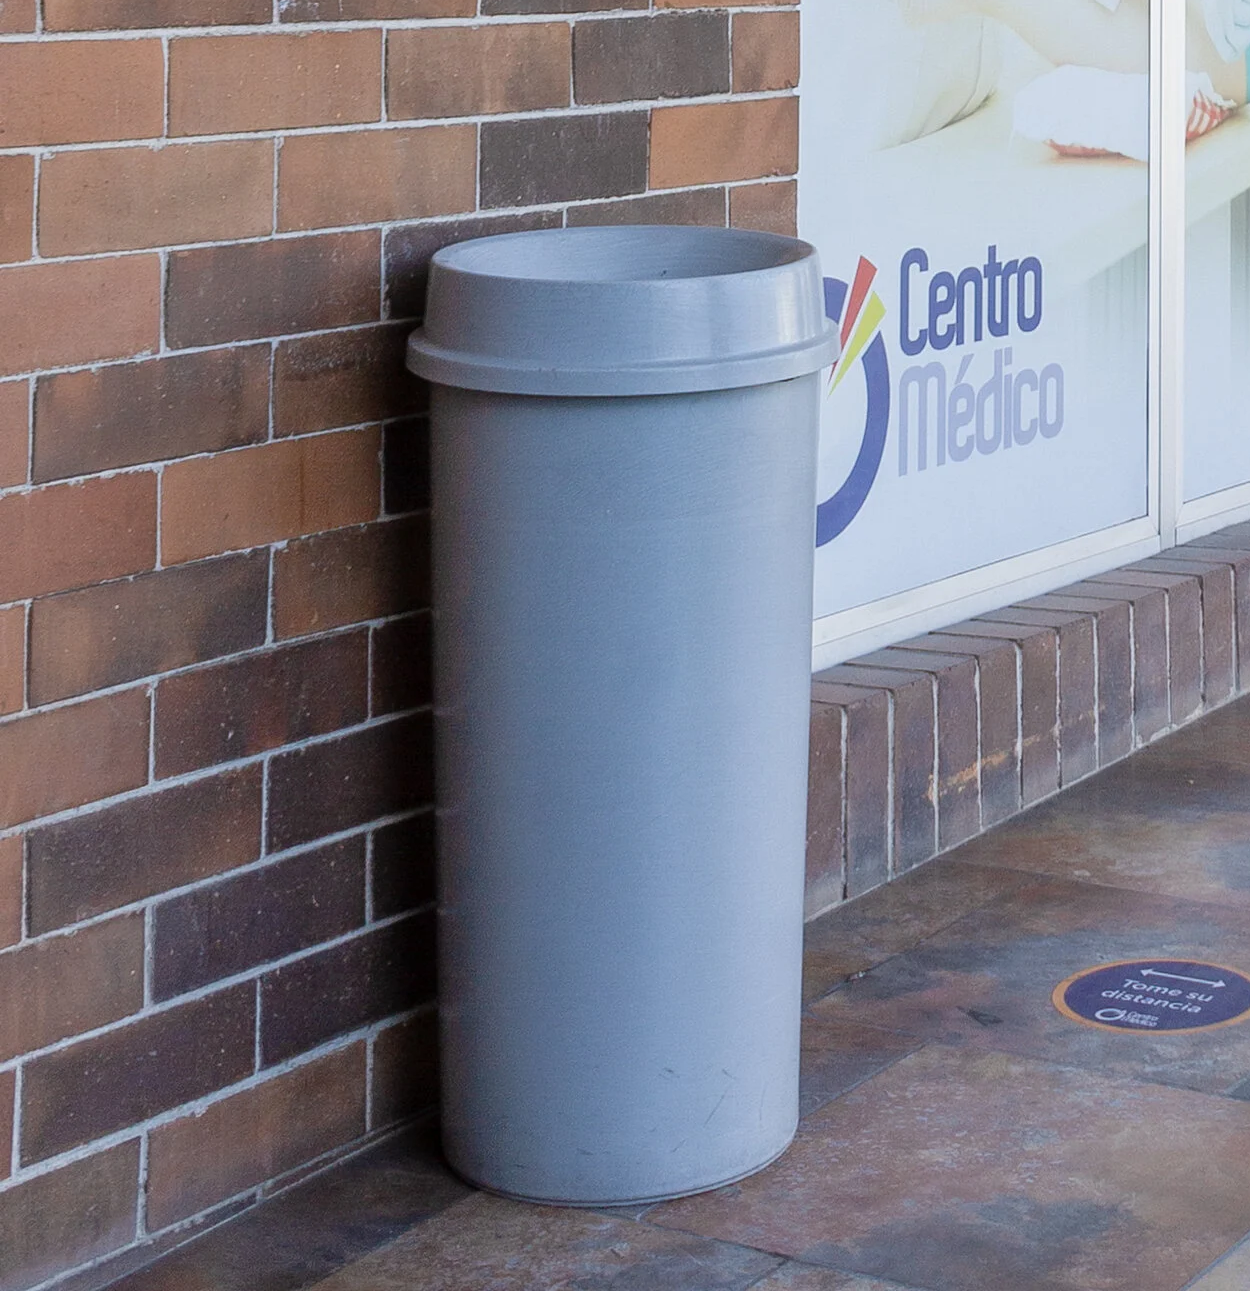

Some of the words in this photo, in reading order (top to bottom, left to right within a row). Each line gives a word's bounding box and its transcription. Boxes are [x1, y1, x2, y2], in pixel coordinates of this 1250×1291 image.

[899, 244, 1043, 357] Centro
[898, 346, 1064, 477] Médico
[1101, 989, 1202, 1014] distancia
[1123, 979, 1183, 997] Tome
[1186, 991, 1214, 1003] su
